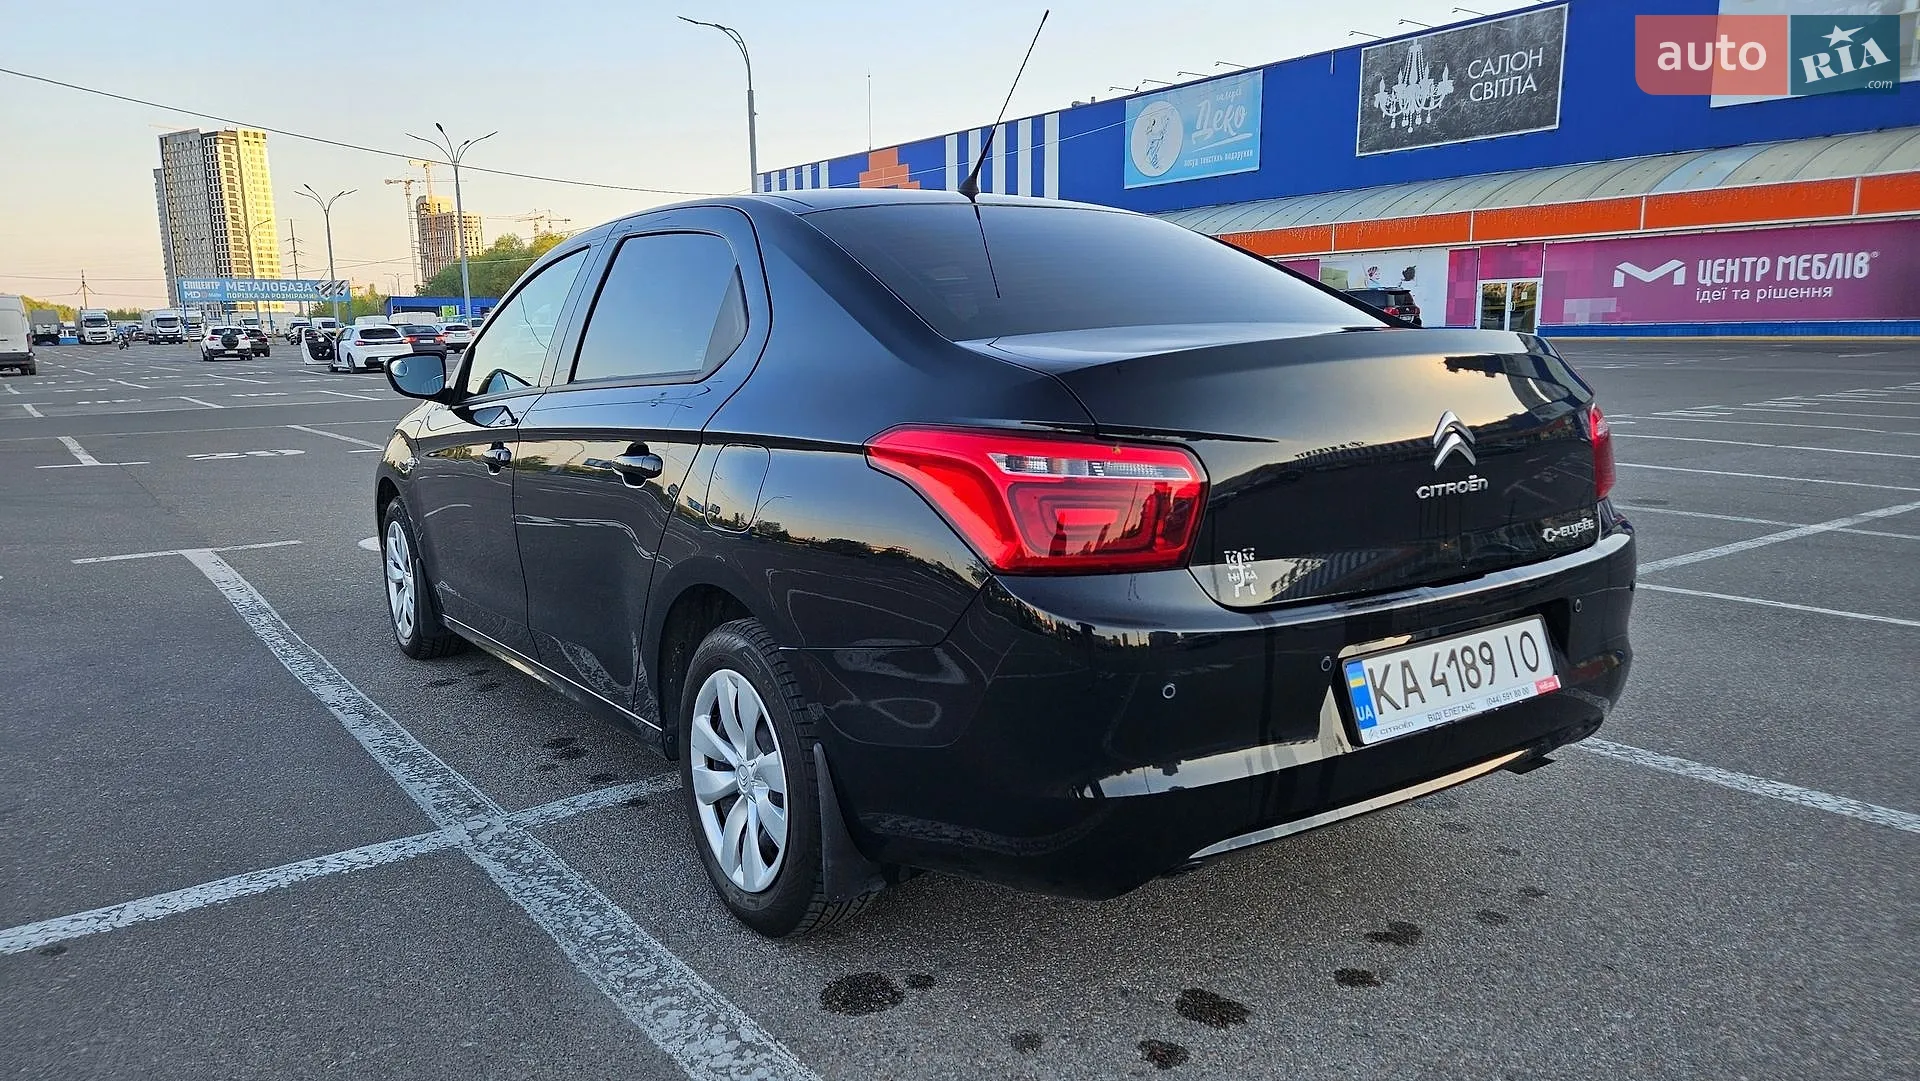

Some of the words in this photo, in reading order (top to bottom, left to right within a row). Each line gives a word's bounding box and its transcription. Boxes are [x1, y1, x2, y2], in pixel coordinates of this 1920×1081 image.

[1467, 47, 1543, 79] САЛОН
[1469, 73, 1537, 101] СВІТЛА
[1191, 100, 1247, 145] Деко
[1697, 256, 1771, 286] ЦЕНТР
[226, 281, 313, 292] МЕТАЛОБАЗА
[1696, 286, 1727, 303] ідеї
[1732, 286, 1750, 300] та
[1757, 284, 1833, 303] рішення
[1368, 659, 1426, 715] KA
[1430, 640, 1496, 697] 4189
[1504, 631, 1540, 678] IO
[1357, 707, 1374, 721] UA
[1444, 702, 1476, 719] ЕЛЕГАНС
